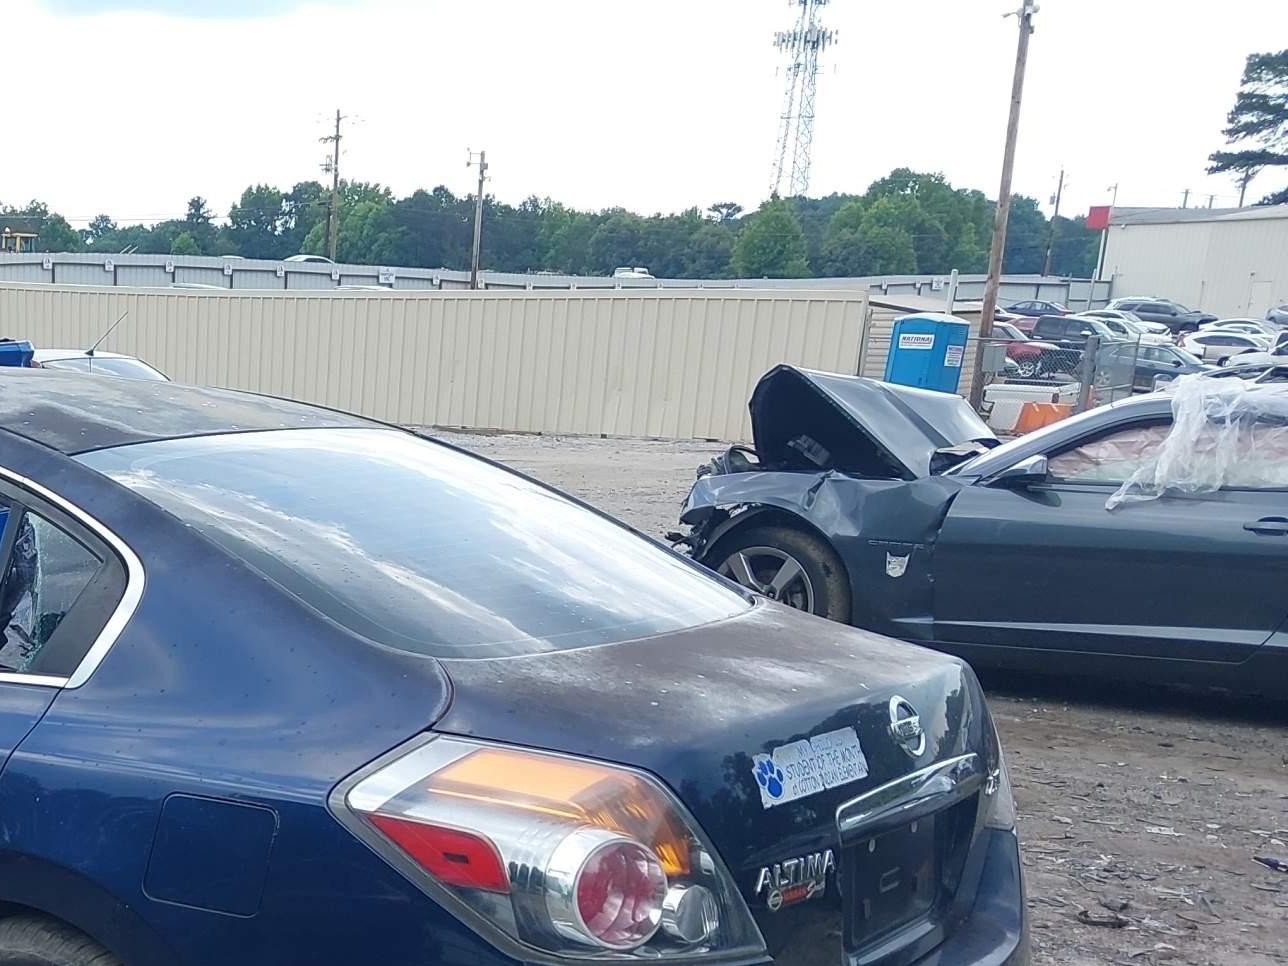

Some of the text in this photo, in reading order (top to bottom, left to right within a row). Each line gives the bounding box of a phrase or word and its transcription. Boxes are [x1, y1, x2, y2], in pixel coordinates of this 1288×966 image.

[902, 335, 932, 343] NATIONAL
[786, 757, 814, 780] STUDENT
[826, 748, 840, 767] THE
[757, 849, 836, 893] ALTIMA
